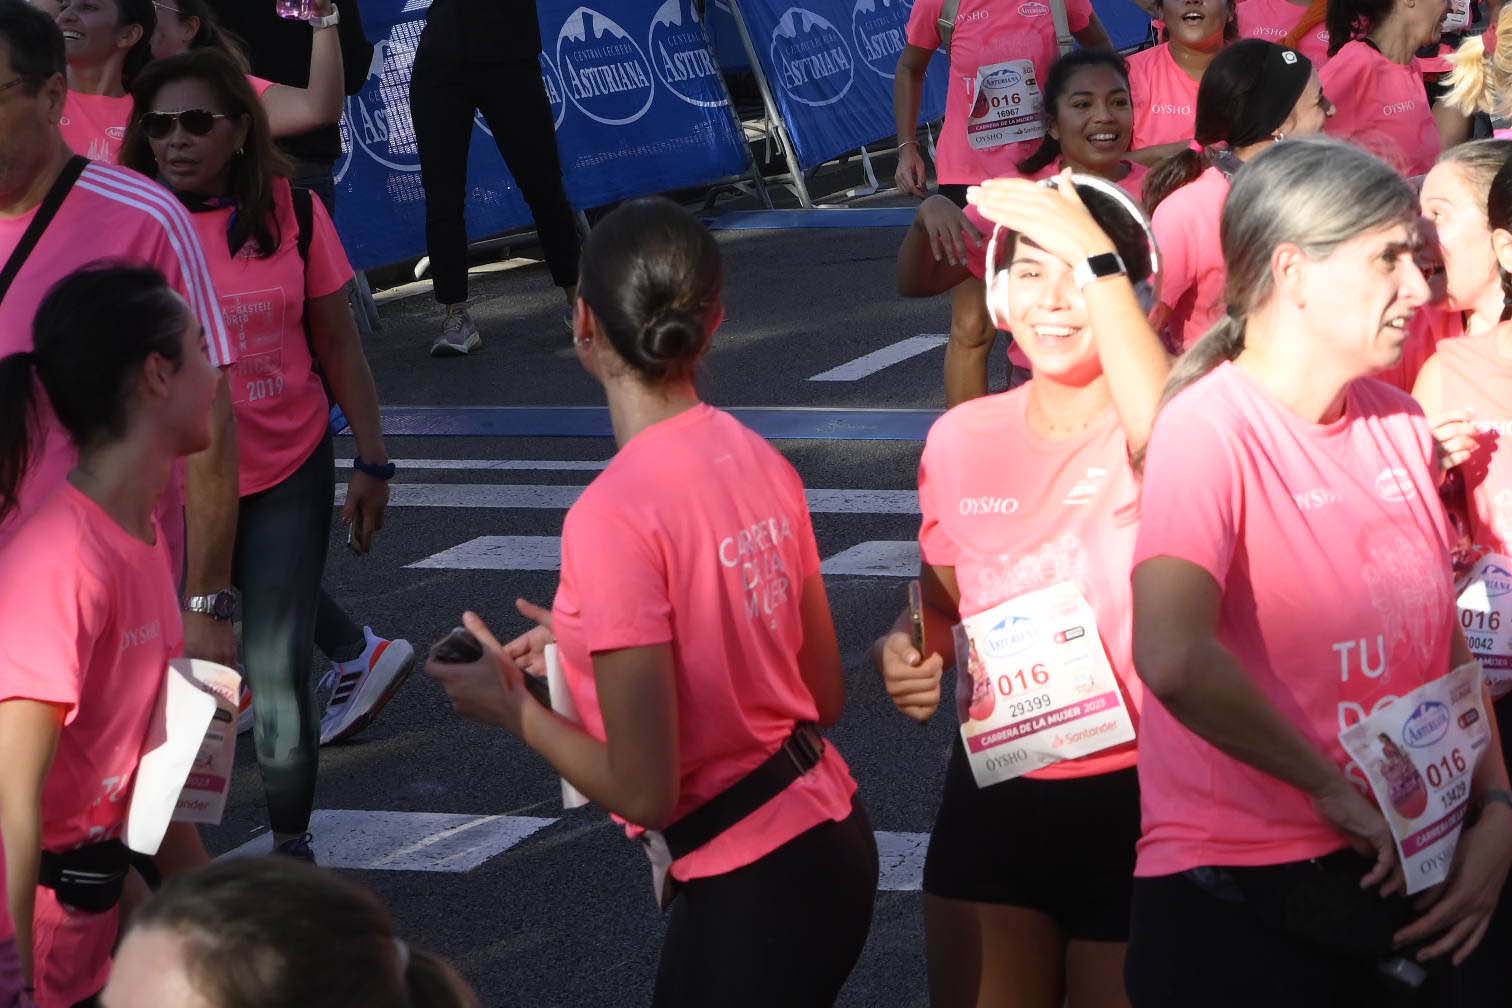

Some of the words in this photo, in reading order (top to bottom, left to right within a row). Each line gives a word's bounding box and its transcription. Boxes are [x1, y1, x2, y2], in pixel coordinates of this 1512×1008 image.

[565, 54, 650, 100] ASTURIANA
[781, 46, 852, 90] ASTURIANA
[991, 93, 1021, 108] 016
[1151, 103, 1192, 116] OYSHO
[1383, 100, 1416, 117] OYSHO
[975, 133, 1003, 143] OYSHO
[959, 496, 1019, 515] OYSHO
[1461, 608, 1501, 631] 016
[1332, 637, 1386, 682] TU
[997, 662, 1051, 697] 016
[1008, 693, 1053, 719] 29399
[980, 724, 1019, 747] CARRERA
[1018, 722, 1032, 735] DE
[1032, 717, 1046, 731] LA
[1047, 706, 1082, 728] MUJER
[985, 747, 1029, 773] OYSHO
[1426, 747, 1467, 789] 016
